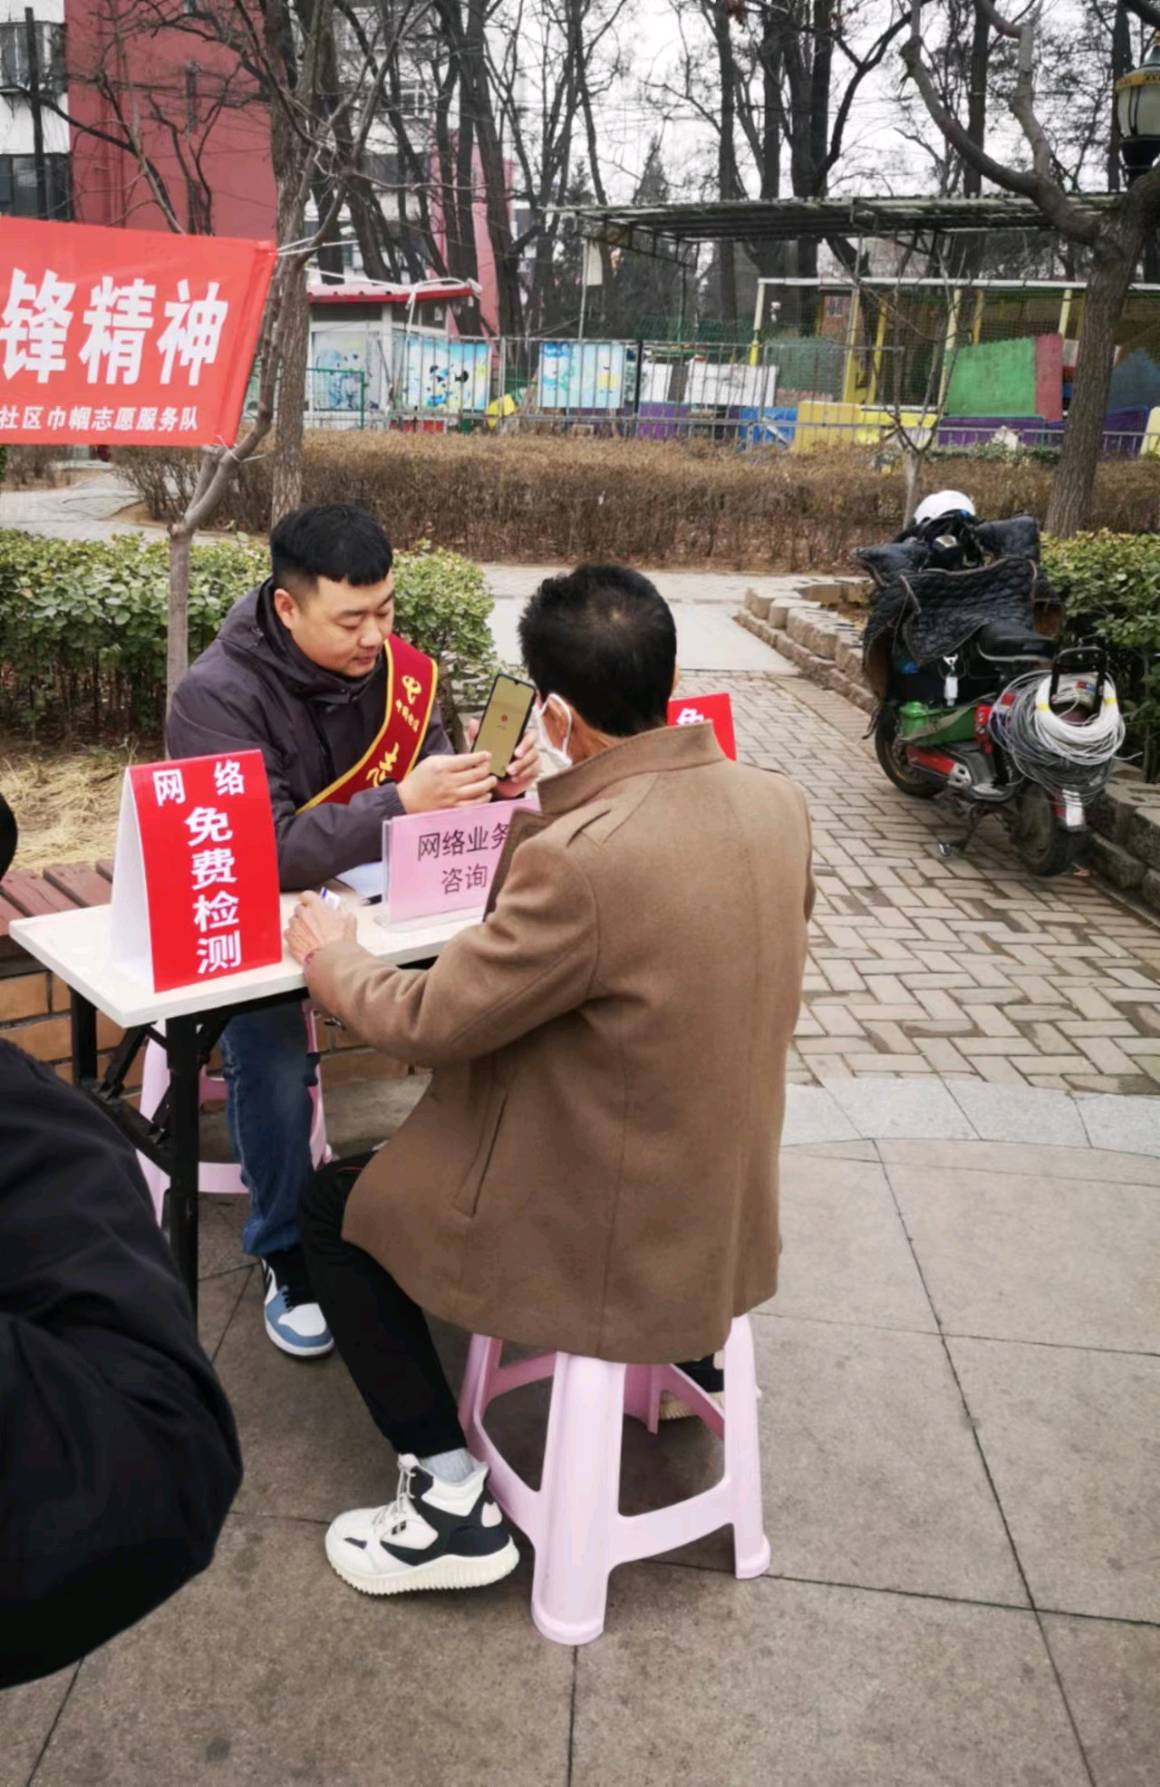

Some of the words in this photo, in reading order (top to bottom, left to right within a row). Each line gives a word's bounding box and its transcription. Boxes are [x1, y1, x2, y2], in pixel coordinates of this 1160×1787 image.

[0, 268, 228, 386] 锋精神
[0, 405, 198, 431] 社区巾帼志愿服务队
[153, 760, 245, 806] 网络
[417, 822, 510, 861] 网络业务
[184, 807, 242, 974] 免费检测
[442, 863, 488, 895] 咨询
